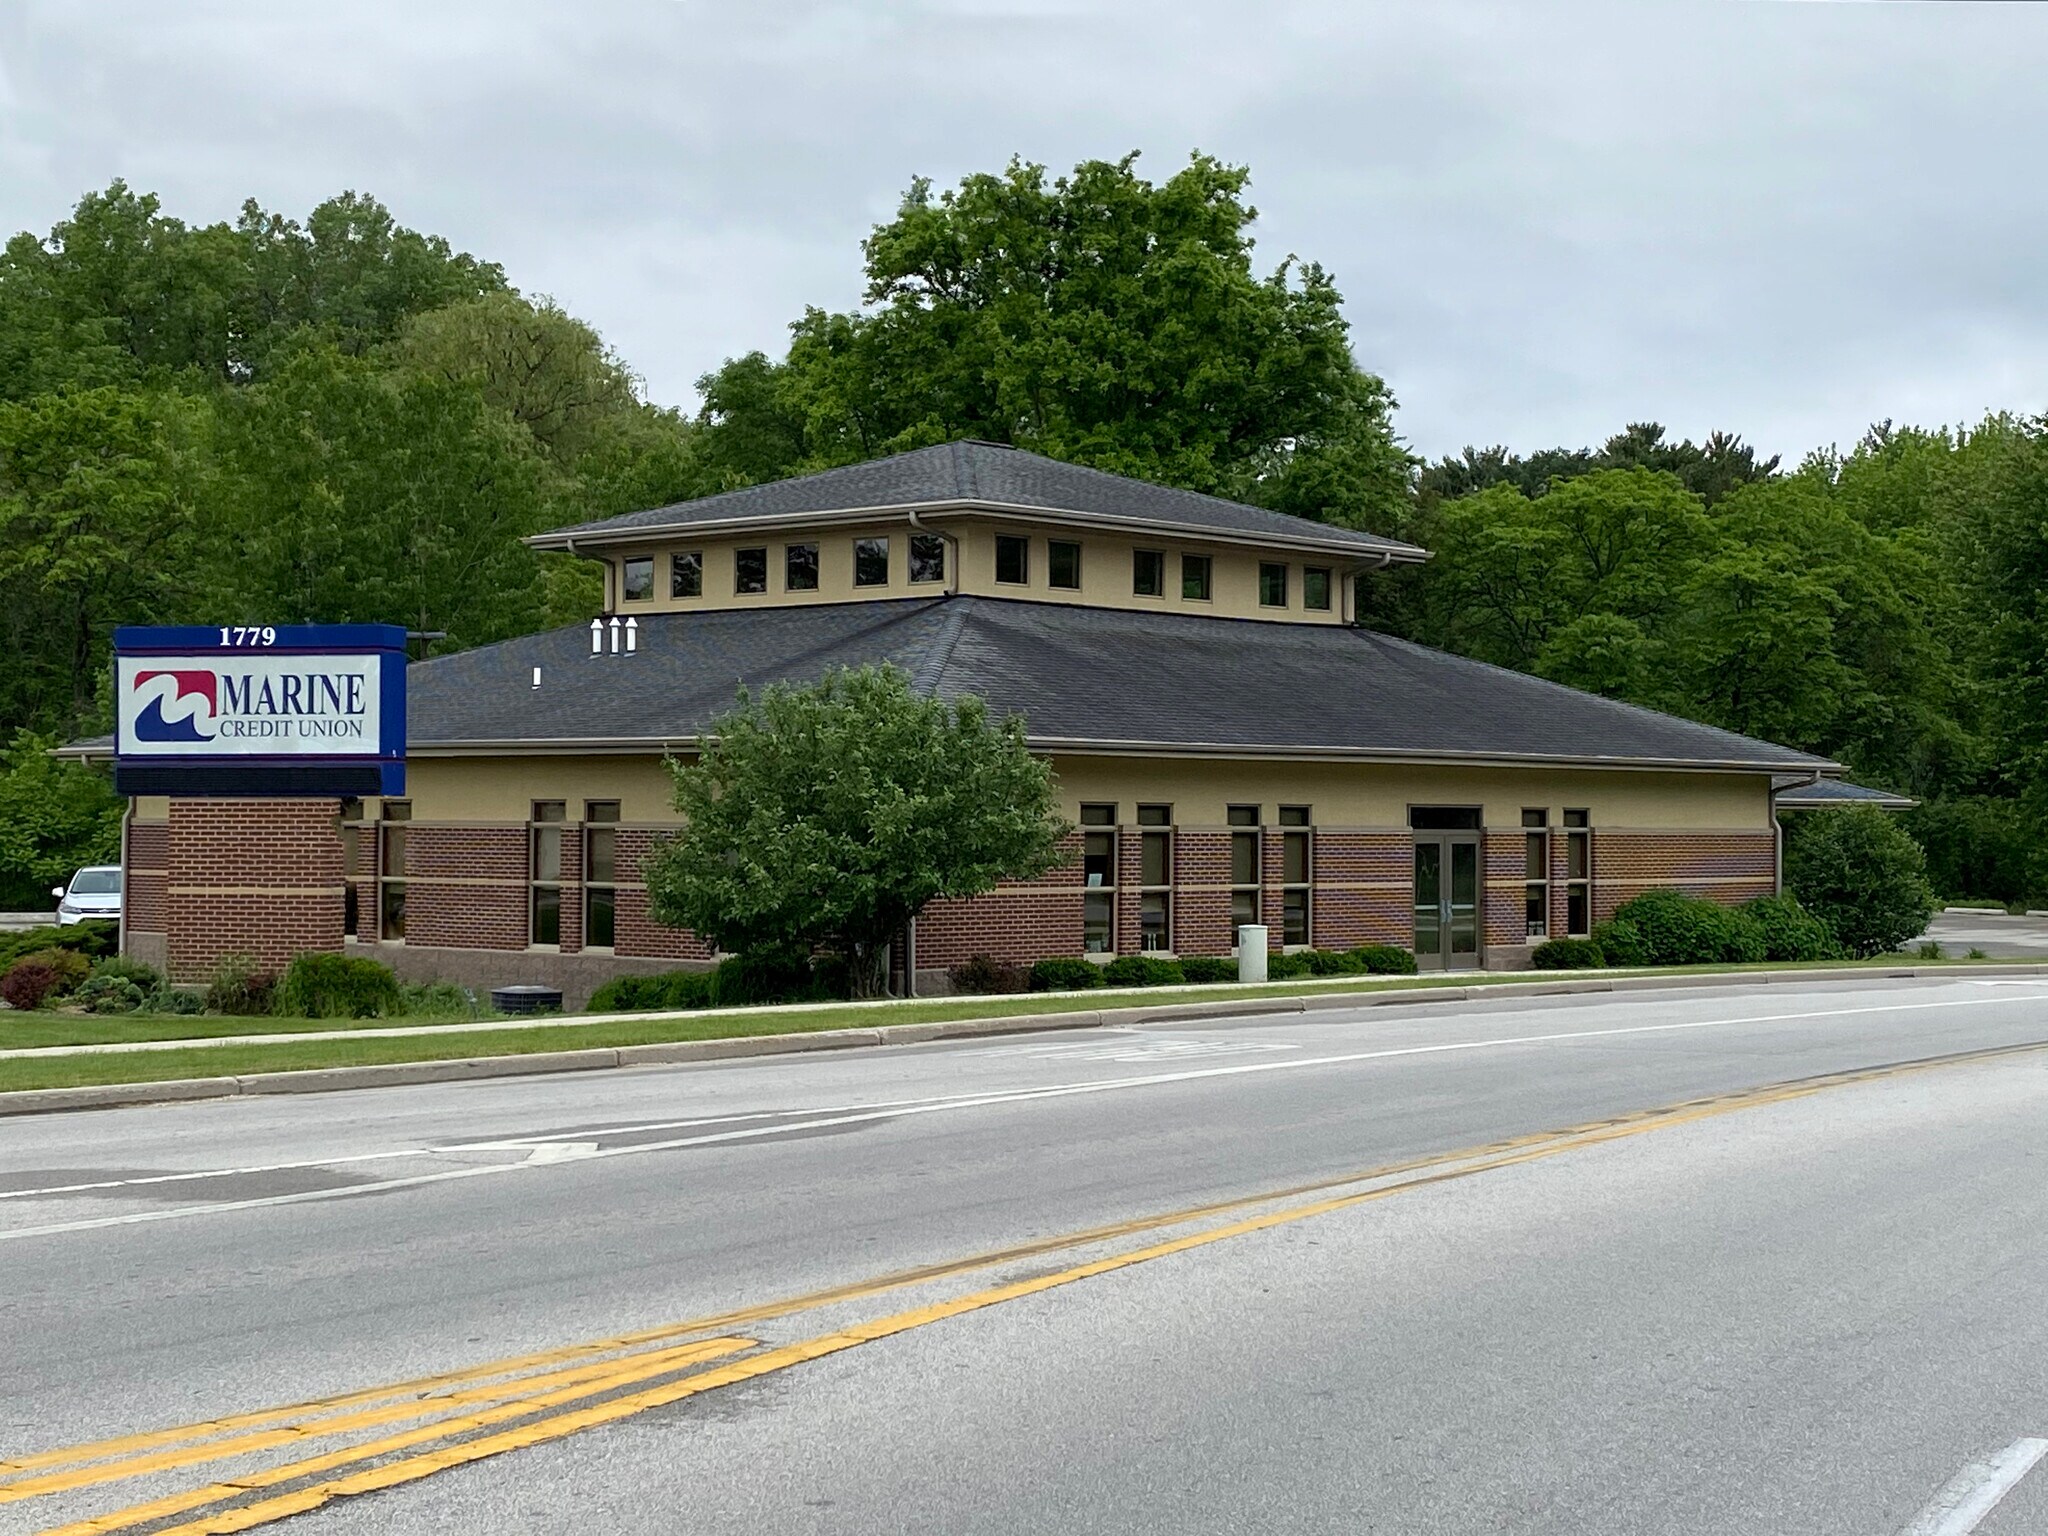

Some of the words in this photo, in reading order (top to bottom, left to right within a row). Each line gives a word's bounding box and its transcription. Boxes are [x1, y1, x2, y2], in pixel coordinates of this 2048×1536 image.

[219, 627, 276, 646] 1779
[221, 674, 366, 715] MARINE
[220, 720, 293, 738] CREDIT
[299, 720, 363, 738] UNION
